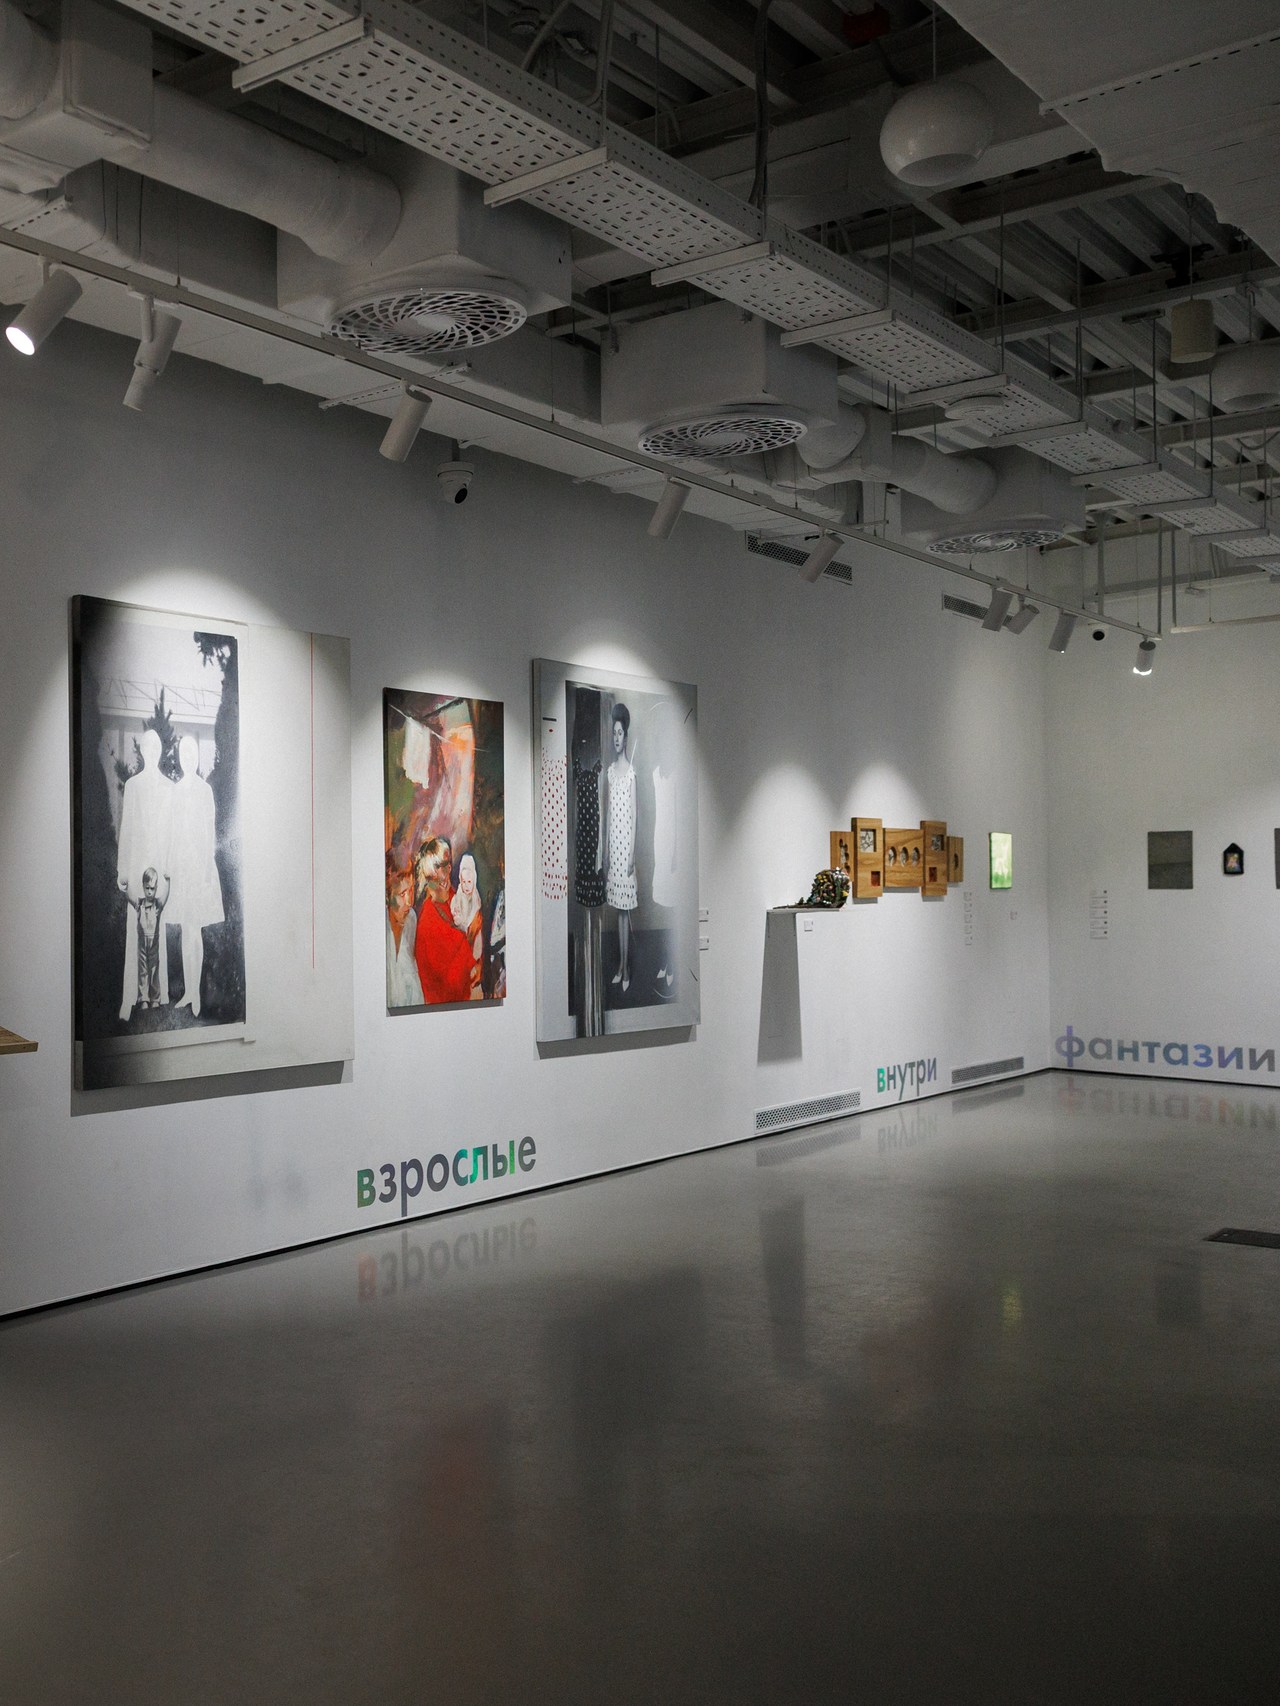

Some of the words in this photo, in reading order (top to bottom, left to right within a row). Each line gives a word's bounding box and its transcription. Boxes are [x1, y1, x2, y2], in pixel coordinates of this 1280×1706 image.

[1055, 1025, 1276, 1072] фантазии
[876, 1057, 937, 1100] внутри
[357, 1136, 537, 1217] взрослые
